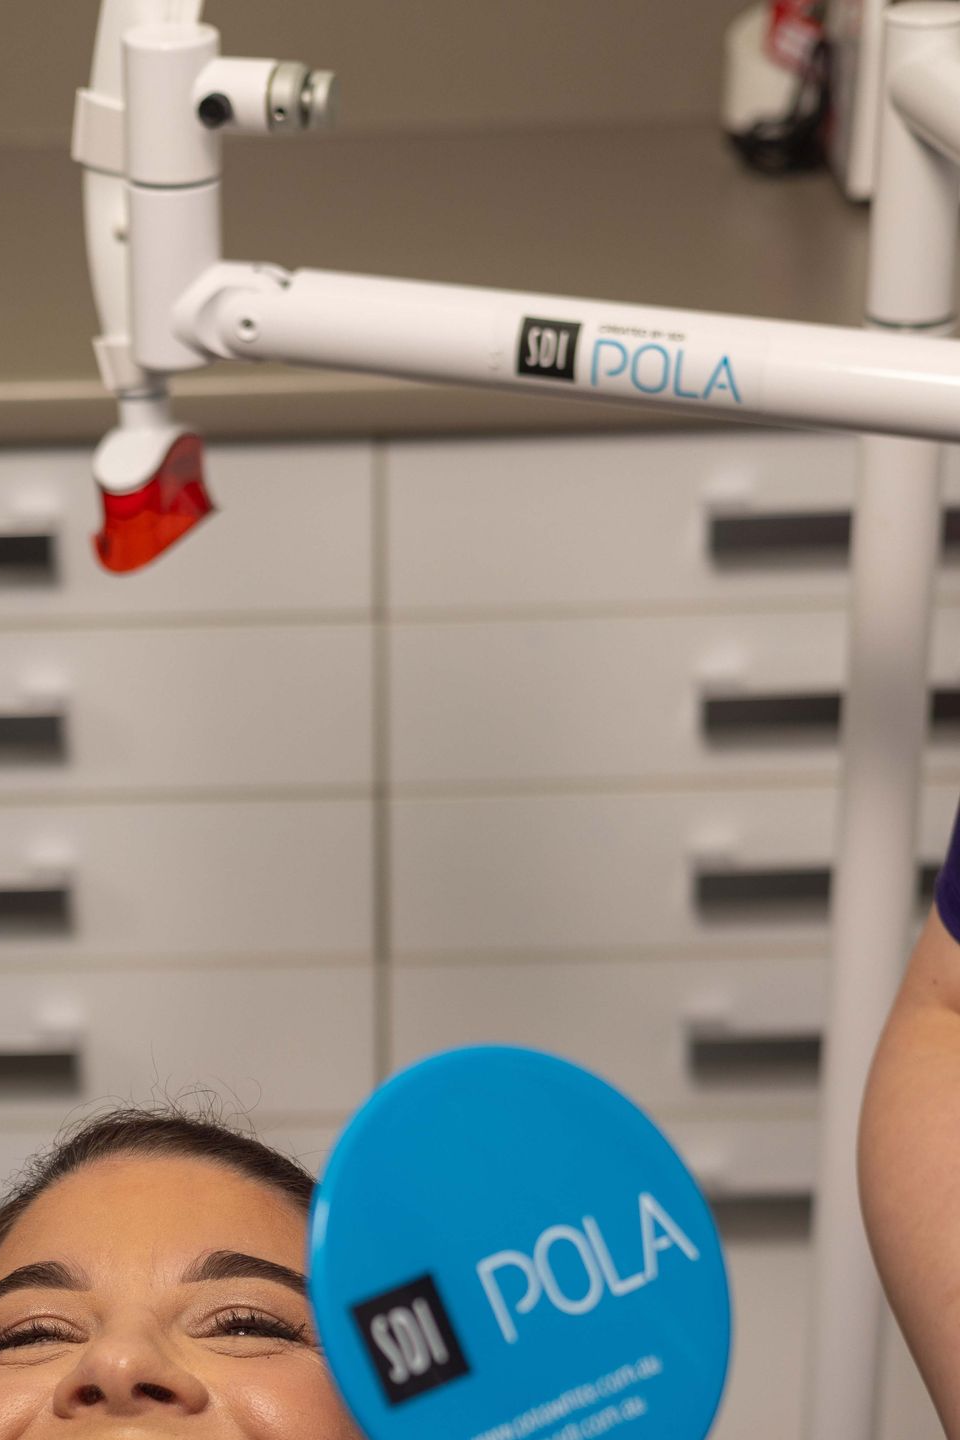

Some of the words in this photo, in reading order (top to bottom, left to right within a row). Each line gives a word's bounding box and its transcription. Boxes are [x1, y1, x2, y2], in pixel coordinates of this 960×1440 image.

[525, 326, 570, 370] SDI
[591, 338, 742, 404] POLA
[370, 1296, 450, 1384] SDI
[476, 1191, 701, 1344] POLA
